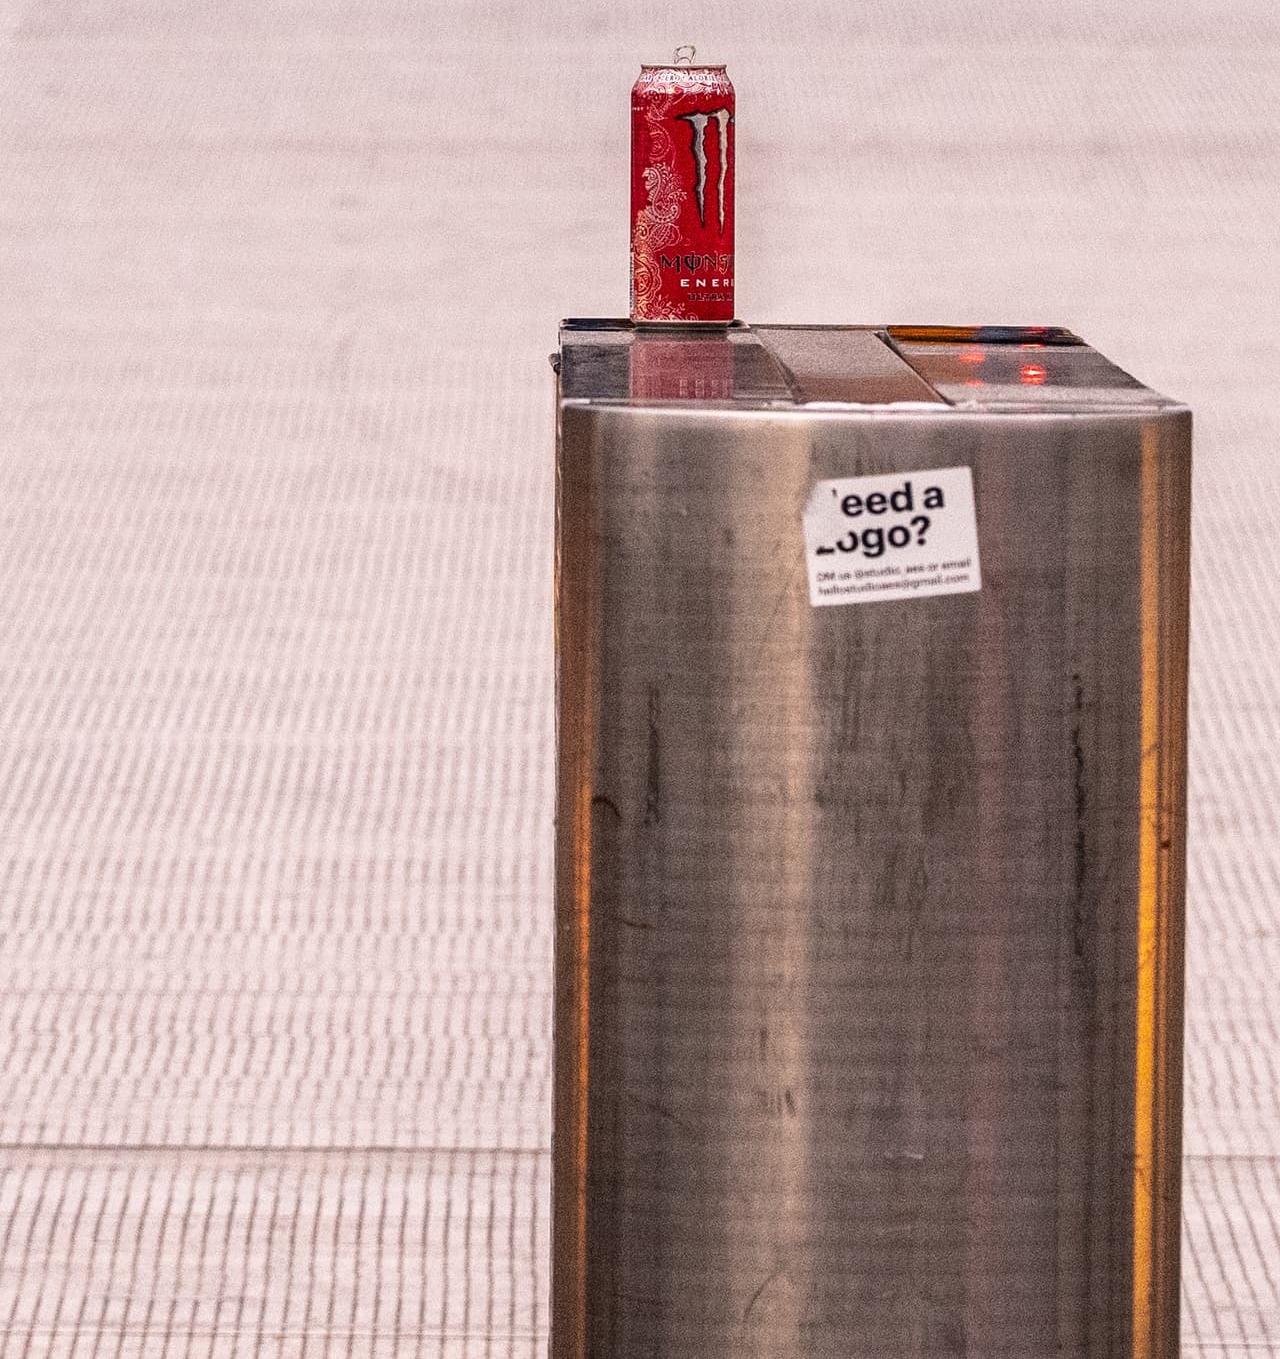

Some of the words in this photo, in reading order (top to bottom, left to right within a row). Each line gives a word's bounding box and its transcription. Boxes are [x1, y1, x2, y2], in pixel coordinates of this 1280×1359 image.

[832, 481, 915, 518] eed
[923, 485, 946, 510] a
[815, 514, 932, 559] ogo?
